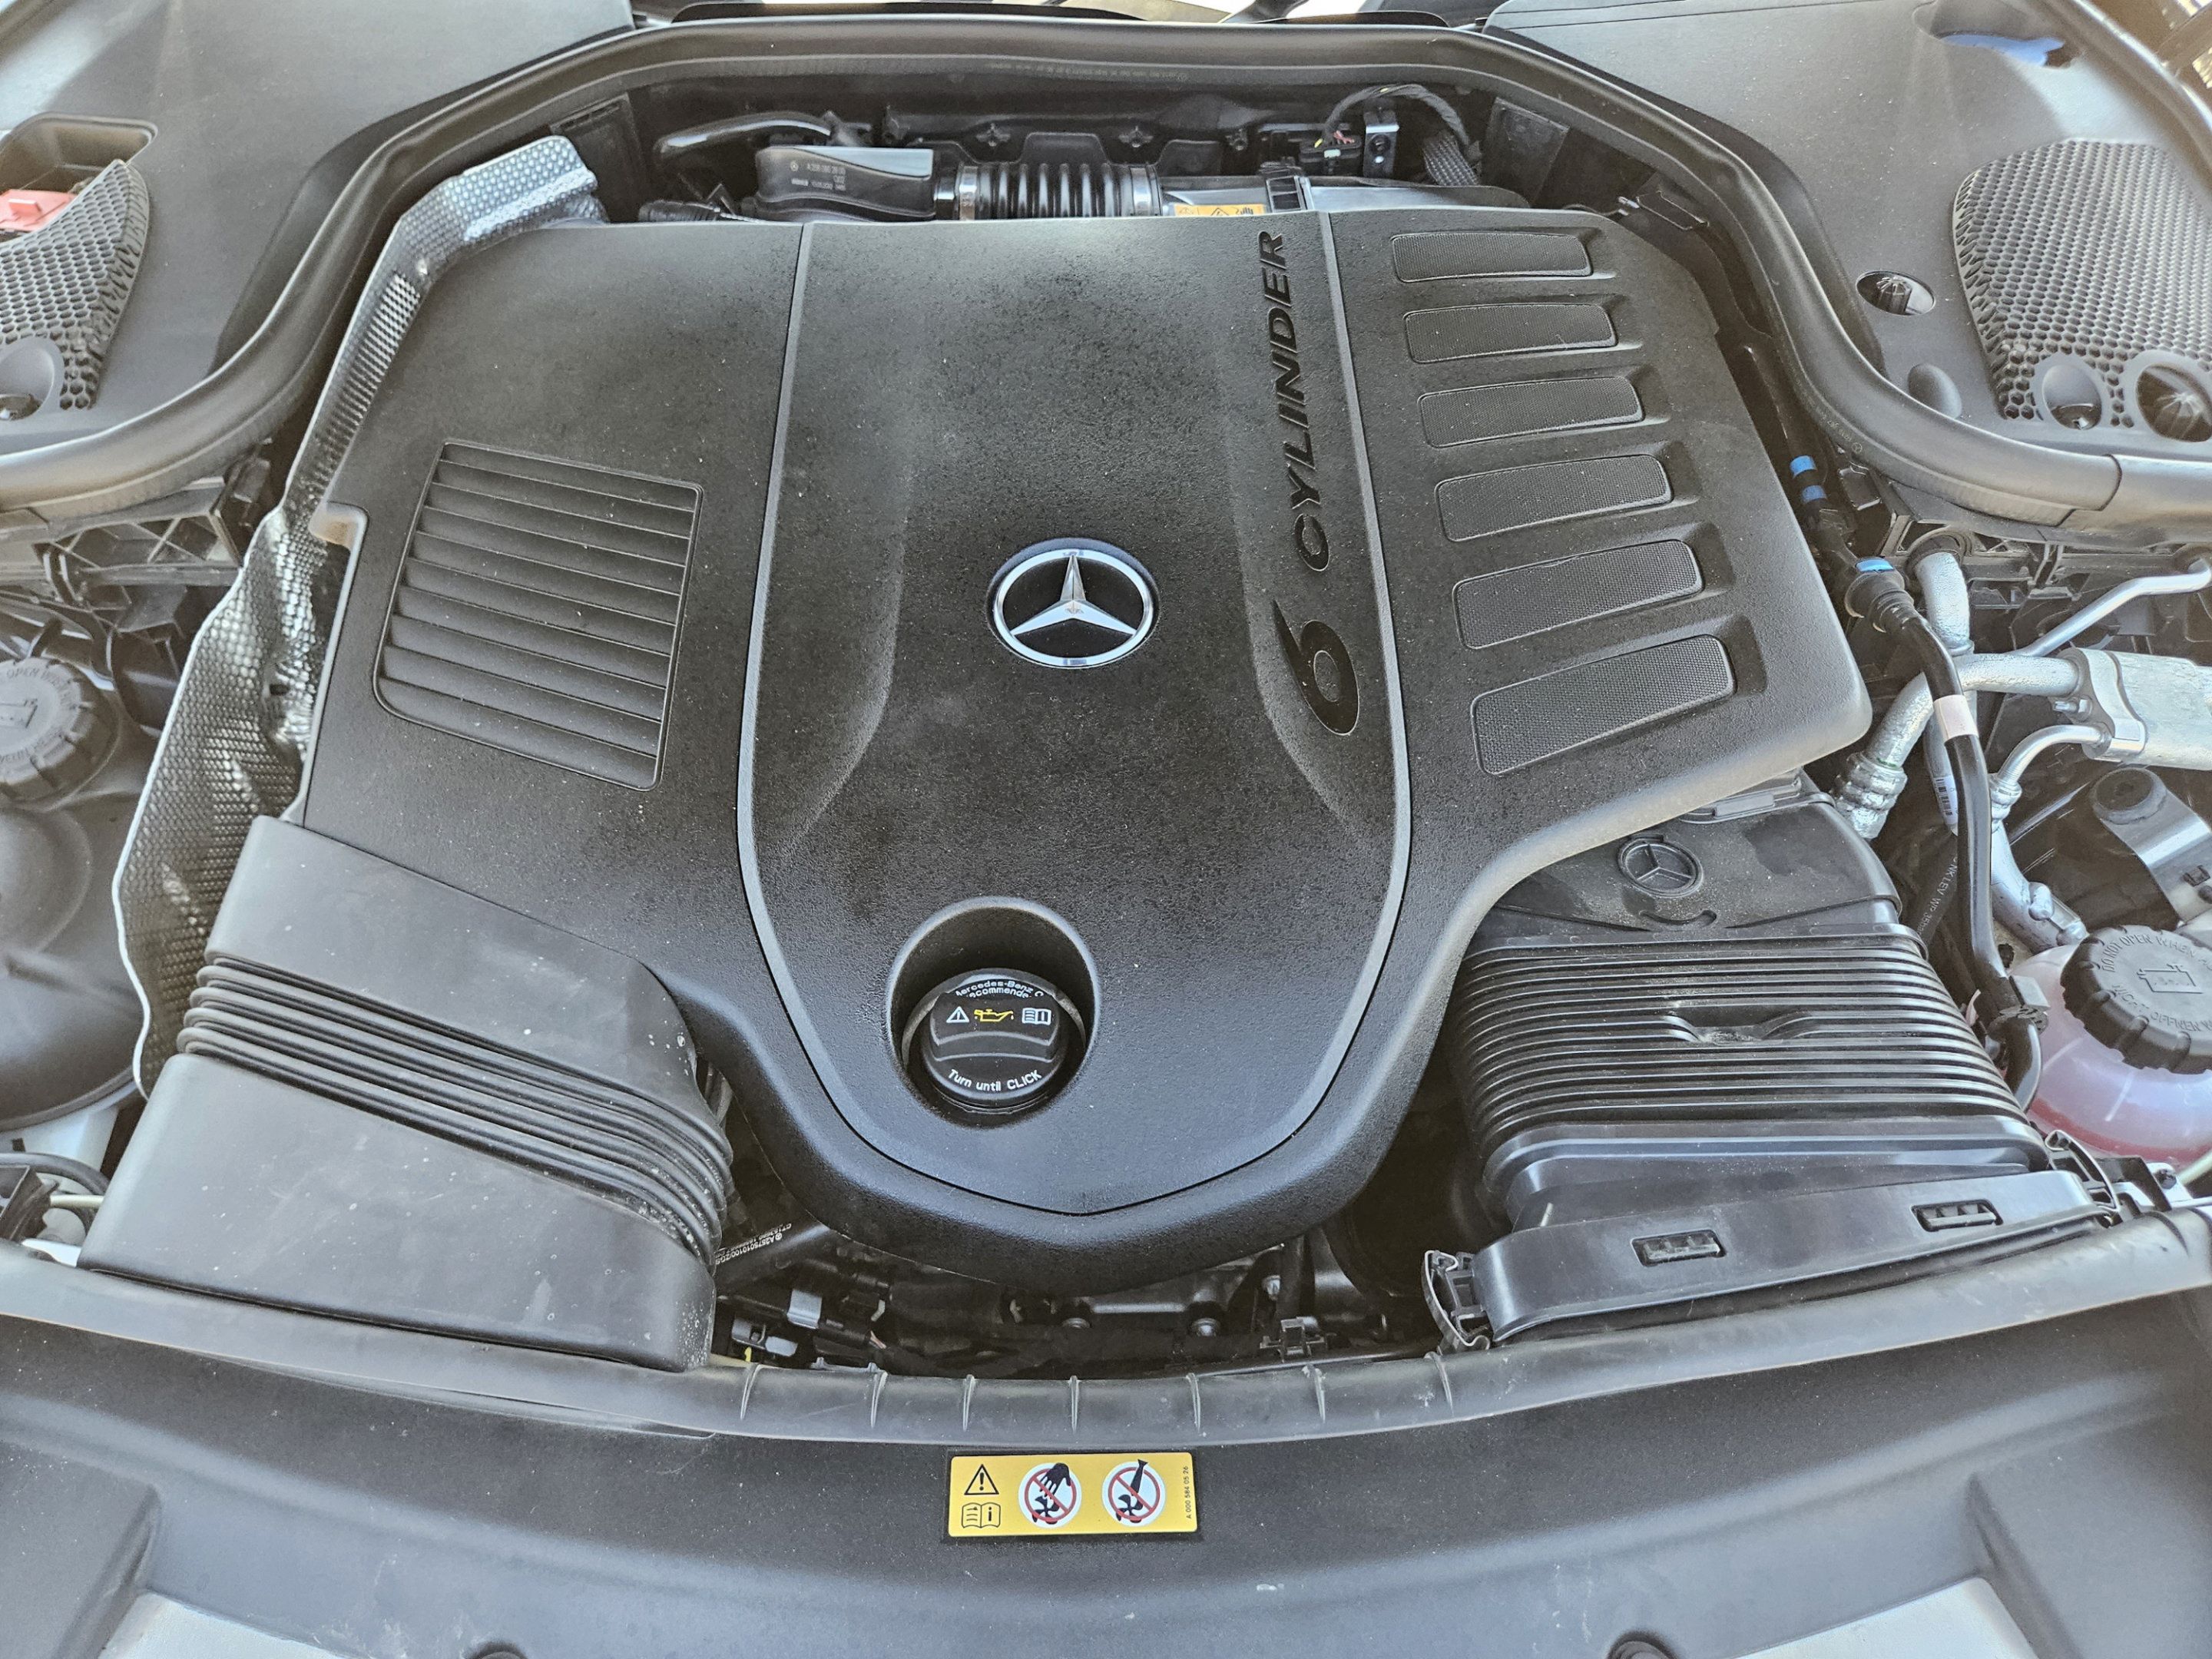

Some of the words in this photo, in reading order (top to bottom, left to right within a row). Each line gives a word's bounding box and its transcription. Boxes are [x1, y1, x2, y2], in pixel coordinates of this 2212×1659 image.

[1257, 230, 1330, 573] CYLINDER
[1272, 598, 1360, 737] 6
[2103, 942, 2123, 959] NOT
[2120, 933, 2153, 946] OPEN
[948, 1069, 972, 1088] Turn
[975, 1081, 1002, 1091] until
[1007, 1069, 1042, 1090] CLICK
[1183, 1475, 1190, 1485] 05
